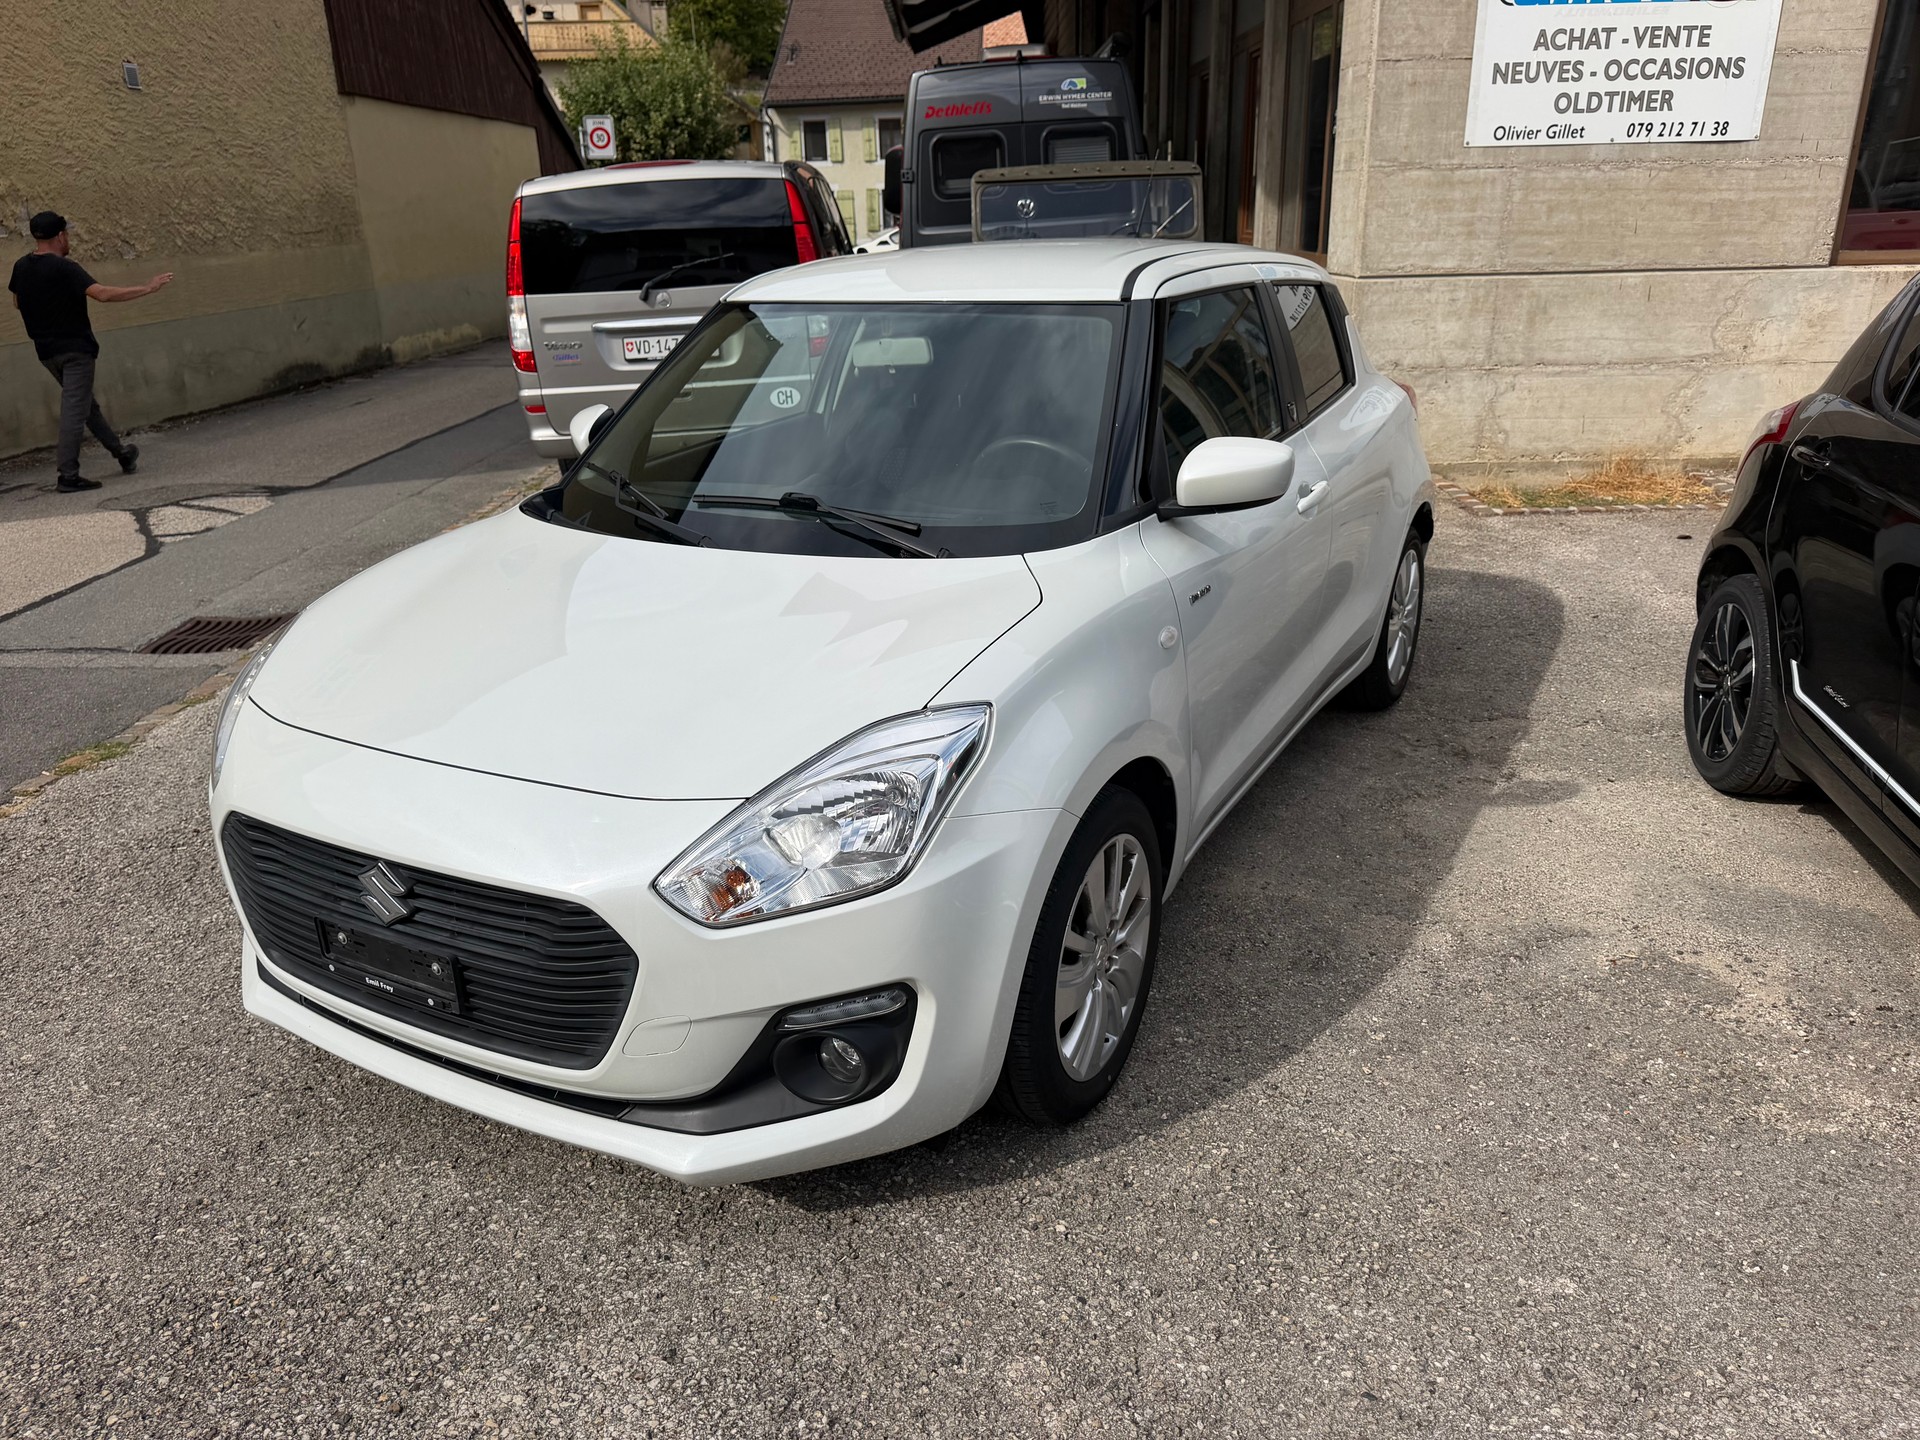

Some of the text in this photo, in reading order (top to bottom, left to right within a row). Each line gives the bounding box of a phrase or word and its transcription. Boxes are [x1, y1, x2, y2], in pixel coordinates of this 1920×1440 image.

[1533, 27, 1617, 51] ACHAT
[1633, 25, 1712, 49] VENTE
[1492, 60, 1584, 84] NEUVES
[1604, 56, 1746, 81] OCCASIONS
[1039, 94, 1061, 102] ERWIN
[1087, 91, 1113, 99] CENTER
[1554, 90, 1674, 114] OLDTIMER
[925, 101, 992, 119] Dethleffs
[1493, 120, 1729, 141] Olivier Gillet 079 212 71 38
[776, 389, 794, 405] CH
[365, 976, 394, 993] Emil Frey
